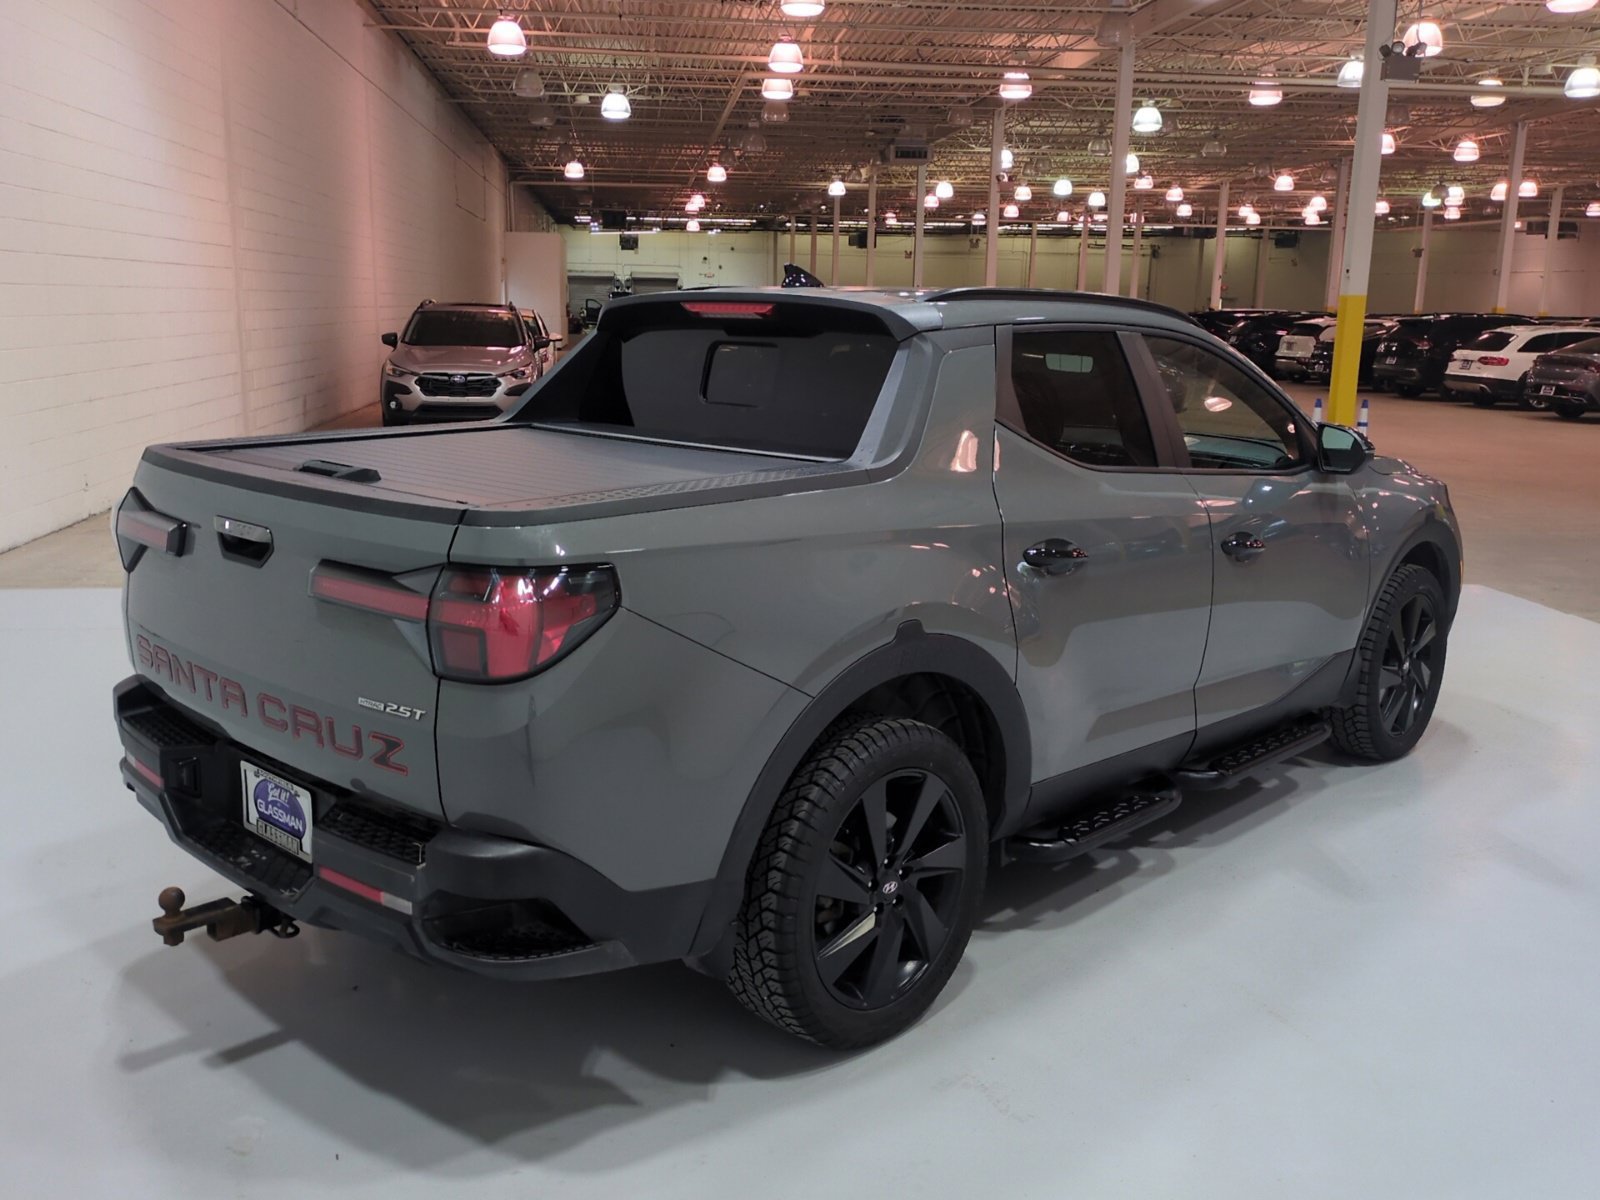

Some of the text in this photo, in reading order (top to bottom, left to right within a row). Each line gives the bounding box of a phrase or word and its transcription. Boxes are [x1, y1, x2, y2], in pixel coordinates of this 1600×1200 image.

[136, 634, 408, 776] SANTA CRUZ
[256, 799, 303, 832] GLASSMAN
